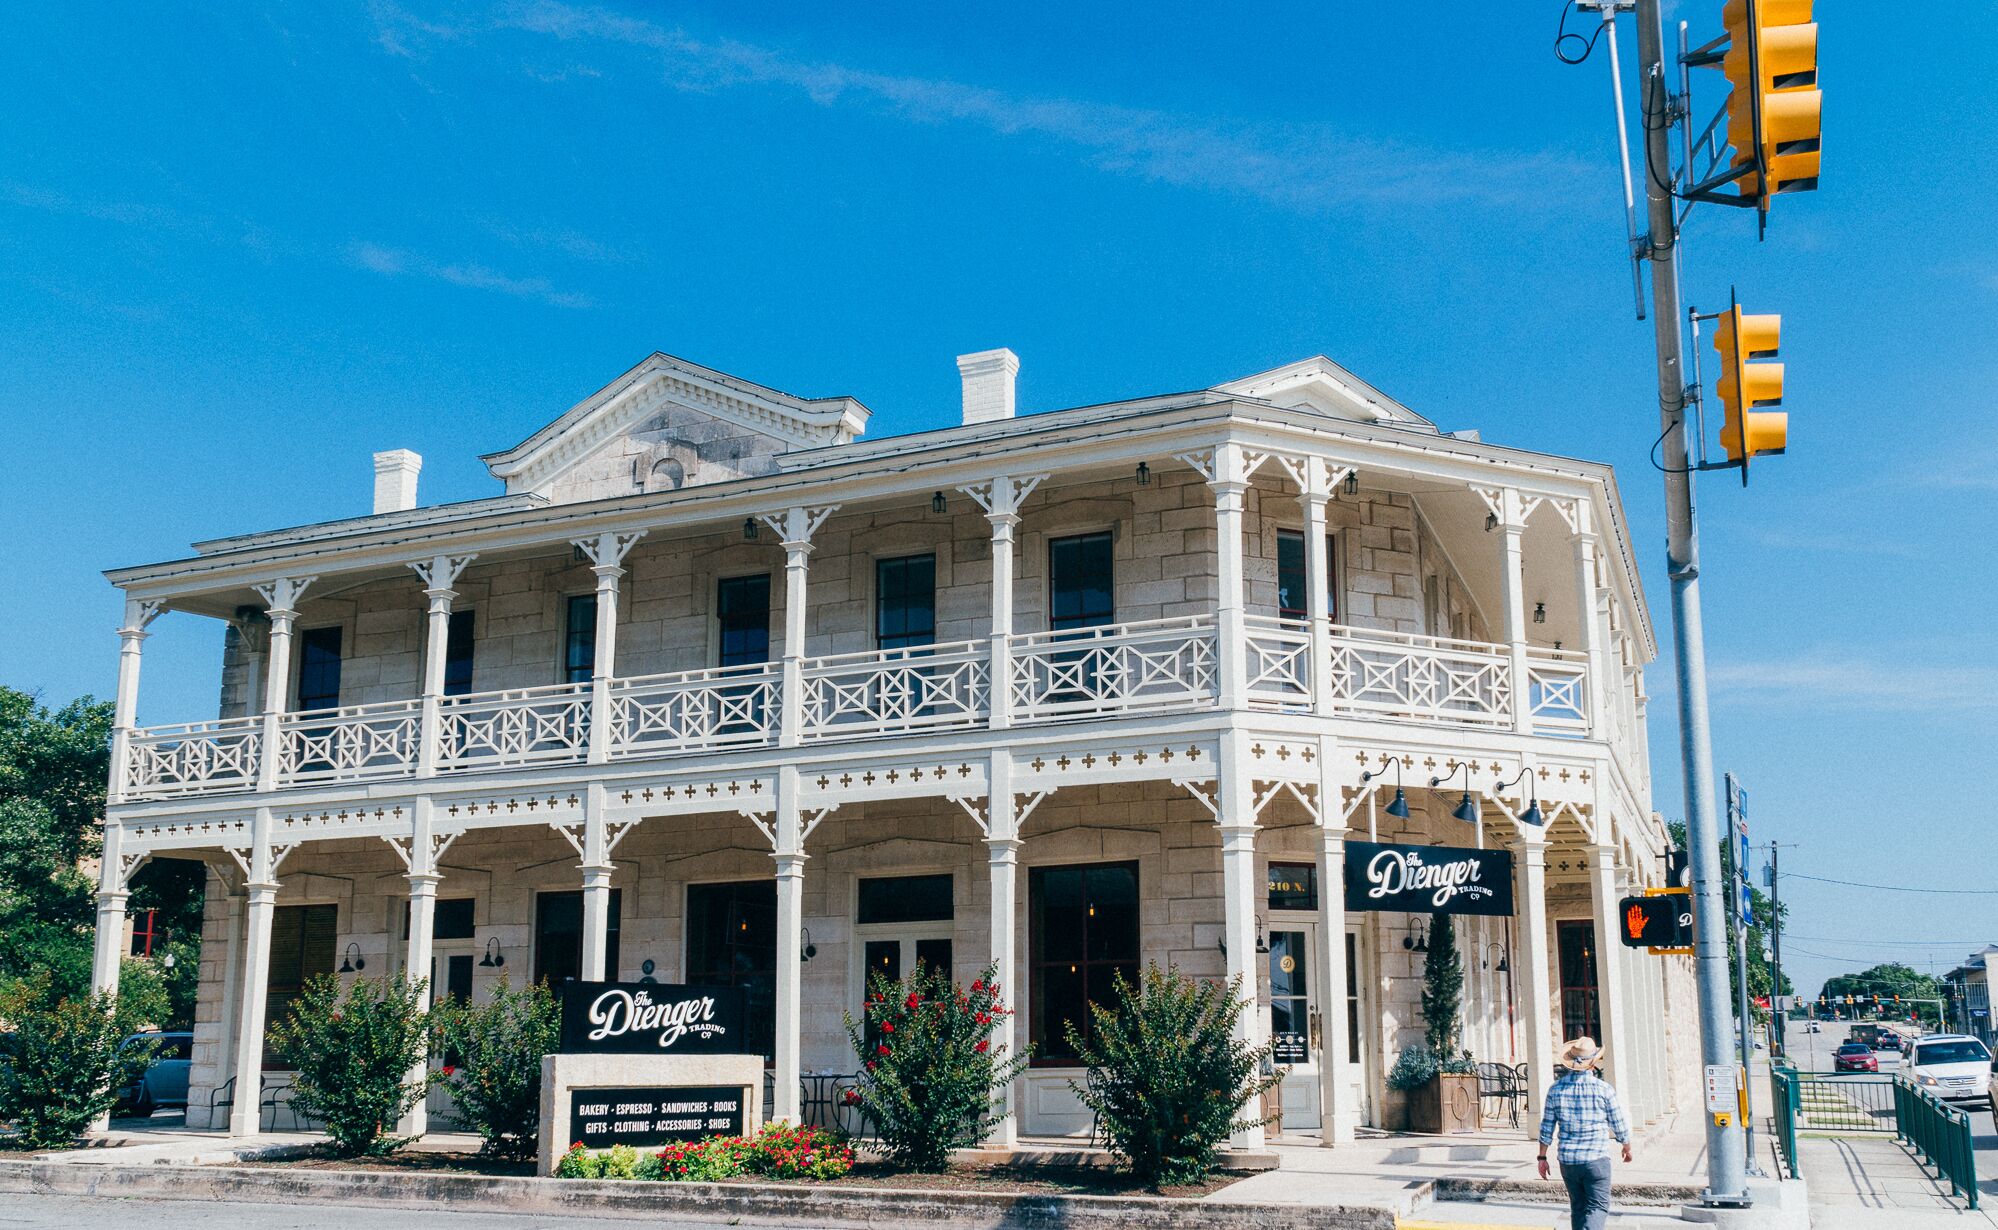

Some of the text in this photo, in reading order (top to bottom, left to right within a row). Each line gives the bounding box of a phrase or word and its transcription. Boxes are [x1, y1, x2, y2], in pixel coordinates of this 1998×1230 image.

[1405, 851, 1423, 867] The
[1268, 881, 1290, 891] 210
[1367, 850, 1481, 907] Dienger
[1458, 885, 1493, 897] TRADING
[634, 990, 653, 1007] The
[588, 989, 715, 1048] Dienger
[688, 1023, 726, 1035] TRADING
[579, 1101, 737, 1116] BAKERY ESPRESSO SANDWICHES BOOKS
[585, 1118, 731, 1134] GIFTS CLOTHING ACCESSORIES SHOES
